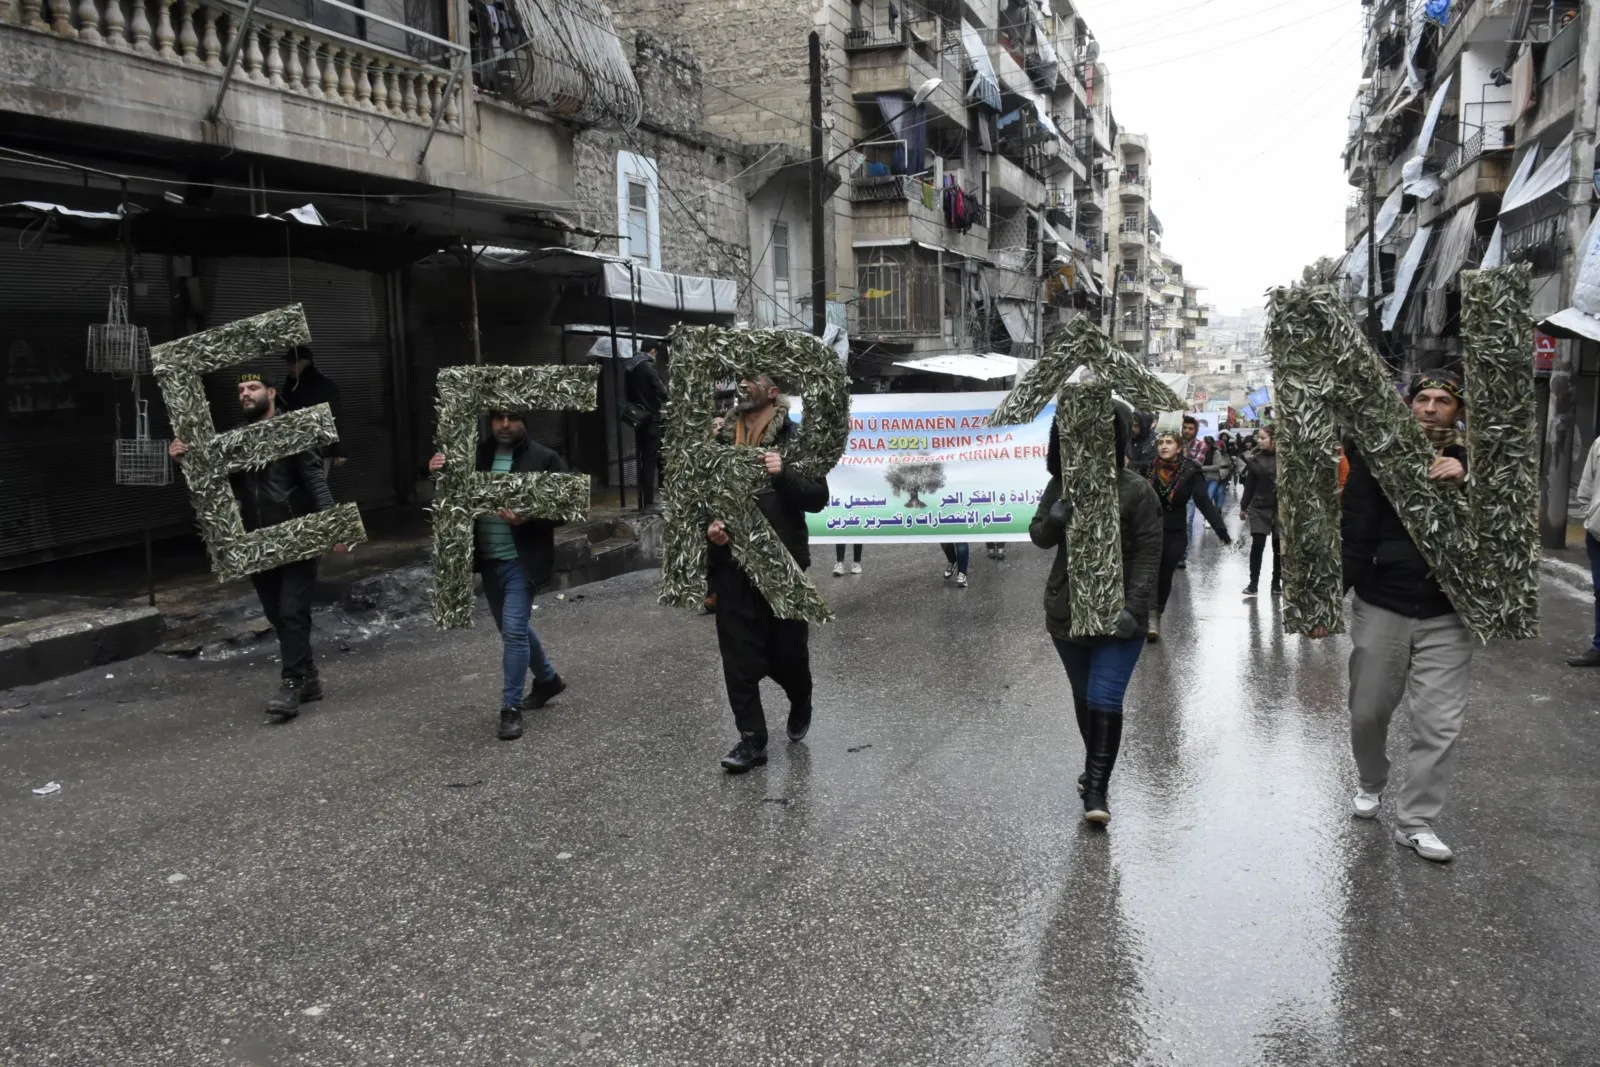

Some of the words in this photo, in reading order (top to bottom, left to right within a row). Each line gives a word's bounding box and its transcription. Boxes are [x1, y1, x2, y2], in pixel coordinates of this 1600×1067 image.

[849, 416, 864, 430] ÎN
[868, 416, 877, 430] Û
[881, 415, 956, 430] RAMANÊN
[960, 416, 988, 429] AZA
[849, 438, 886, 450] SALA
[888, 436, 928, 449] 2021
[931, 436, 972, 449] BIKIN
[975, 432, 1014, 446] SALA
[841, 456, 885, 465] TINAN
[901, 453, 955, 463] RIZGAR
[959, 447, 1010, 460] KIRINA
[1013, 443, 1048, 459] EFRÎ
[844, 494, 887, 509] سنجعل
[940, 492, 963, 507] الحر
[966, 490, 996, 506] الفكر
[999, 492, 1006, 505] و
[827, 513, 860, 529] عفرين
[864, 513, 904, 528] تحرير
[906, 513, 913, 527] و
[915, 511, 979, 528] الإنتصارات
[982, 510, 1012, 526] عام
